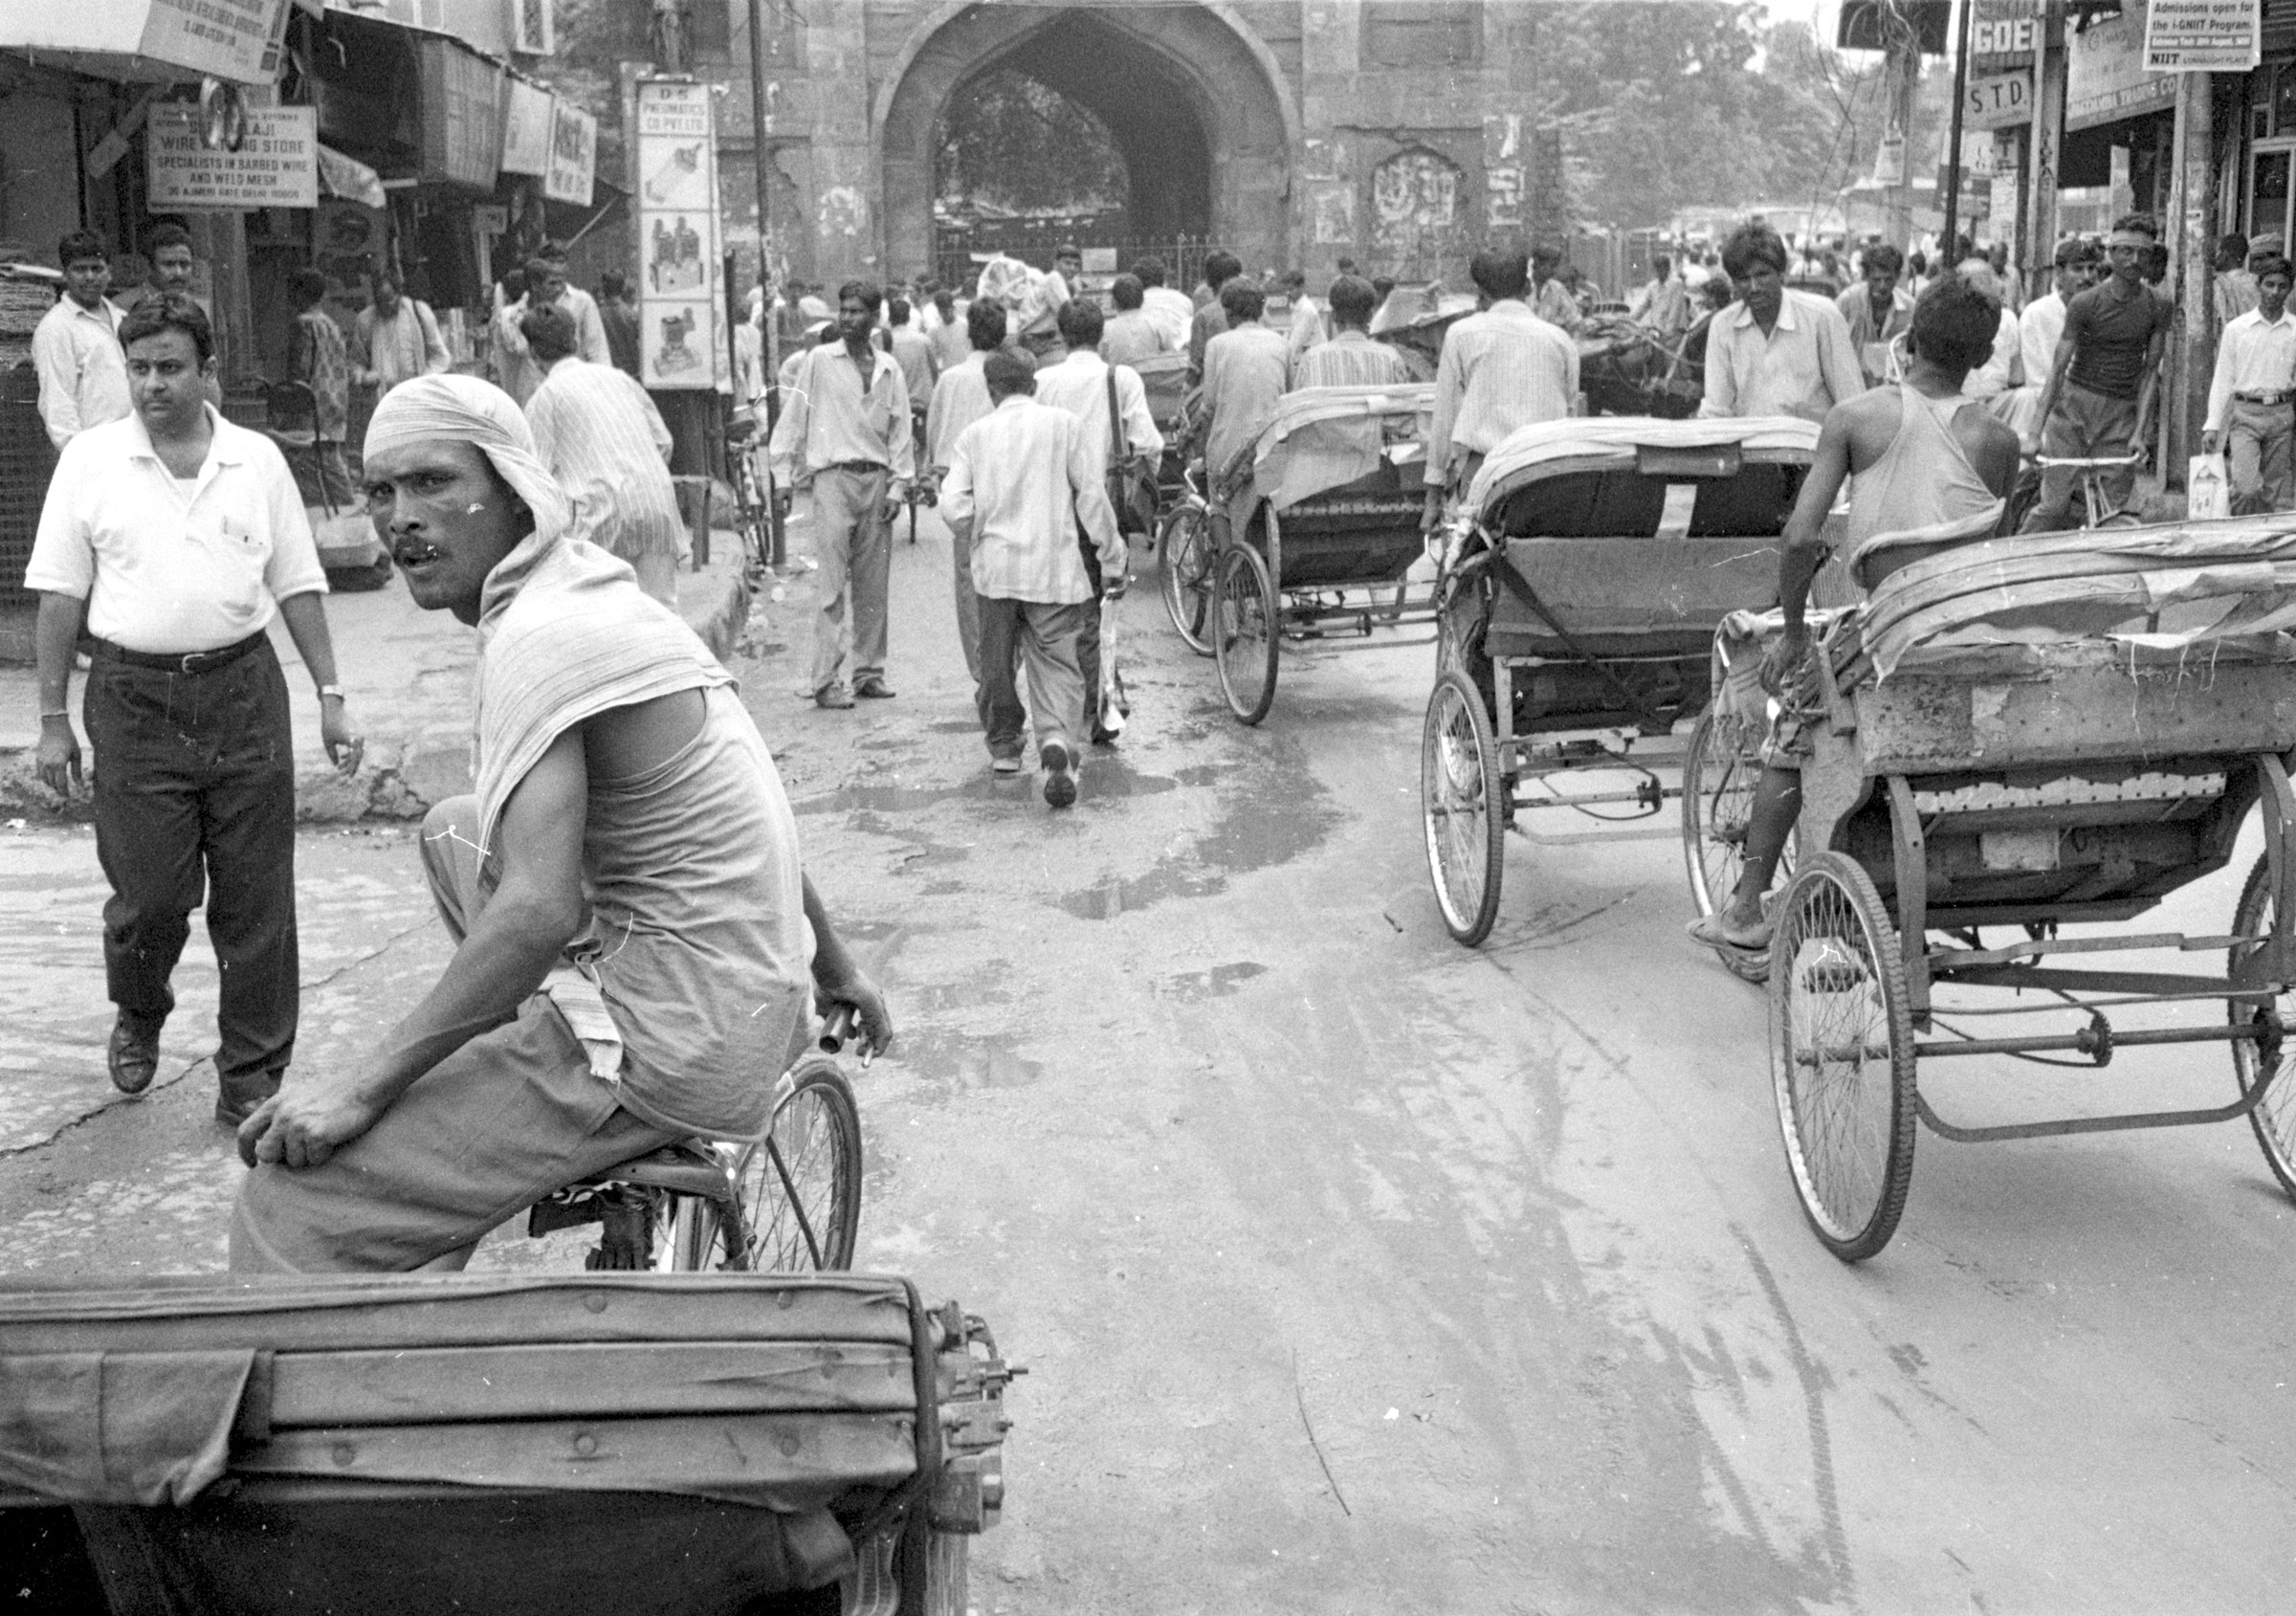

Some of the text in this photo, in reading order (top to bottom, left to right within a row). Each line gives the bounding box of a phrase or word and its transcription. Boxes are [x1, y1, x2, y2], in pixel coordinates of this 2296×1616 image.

[2154, 2, 2254, 14] Admissions open for
[2152, 20, 2169, 31] the
[2173, 19, 2206, 30] i-GNIIT
[2150, 53, 2180, 64] NIIT
[161, 135, 195, 151] WIRE
[262, 140, 304, 154] STORE
[156, 156, 308, 172] SPECIALISTS IN BARBED WIRE
[189, 172, 276, 186] AND WELD MESH
